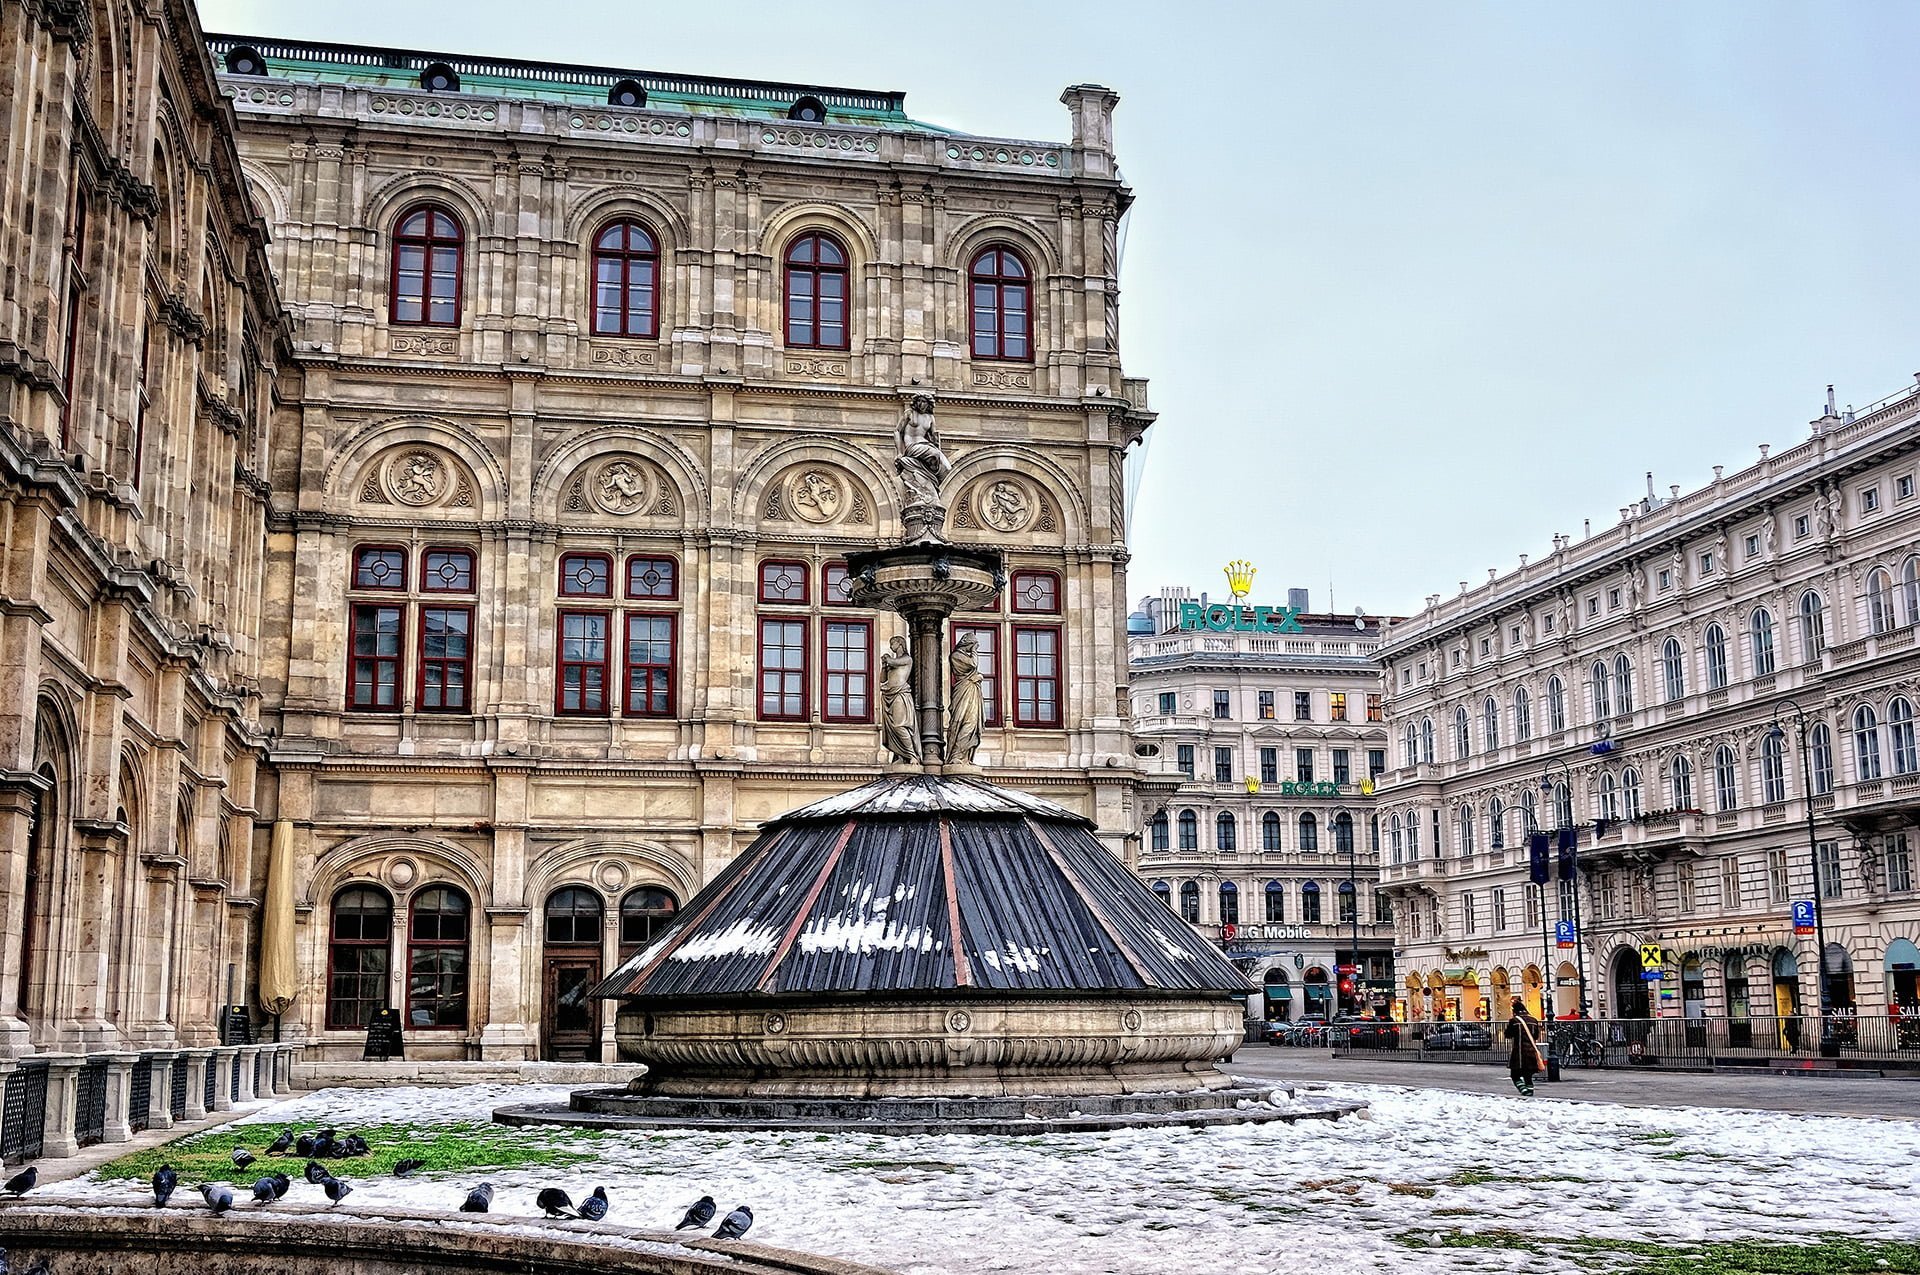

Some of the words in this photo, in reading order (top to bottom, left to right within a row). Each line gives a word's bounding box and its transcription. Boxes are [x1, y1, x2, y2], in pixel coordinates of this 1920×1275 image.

[1180, 603, 1302, 633] ROLEX
[1282, 782, 1341, 796] ROLEX
[1239, 926, 1258, 938] LG
[1264, 926, 1311, 938] Mobile
